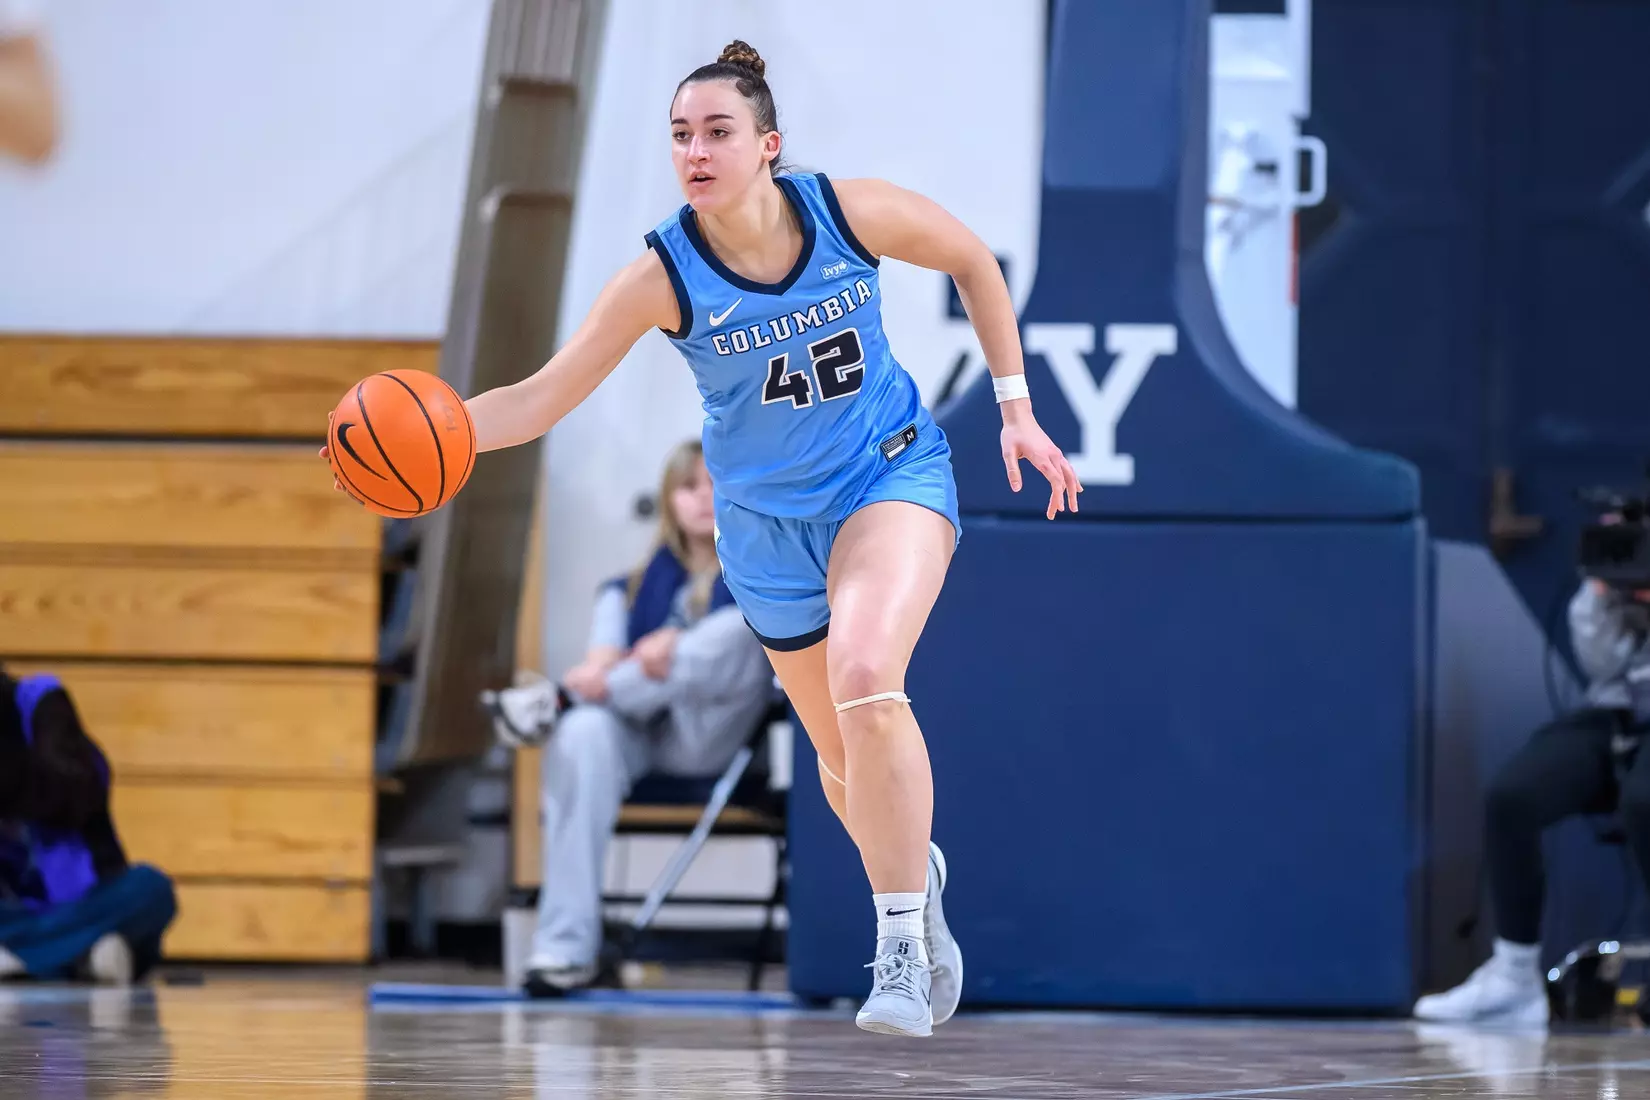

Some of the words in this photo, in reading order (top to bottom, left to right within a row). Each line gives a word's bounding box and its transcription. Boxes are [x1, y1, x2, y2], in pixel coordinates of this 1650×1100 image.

[822, 264, 840, 277] Ivy
[712, 279, 872, 356] COLUMBIA
[761, 327, 865, 410] 42
[1025, 323, 1178, 484] Y
